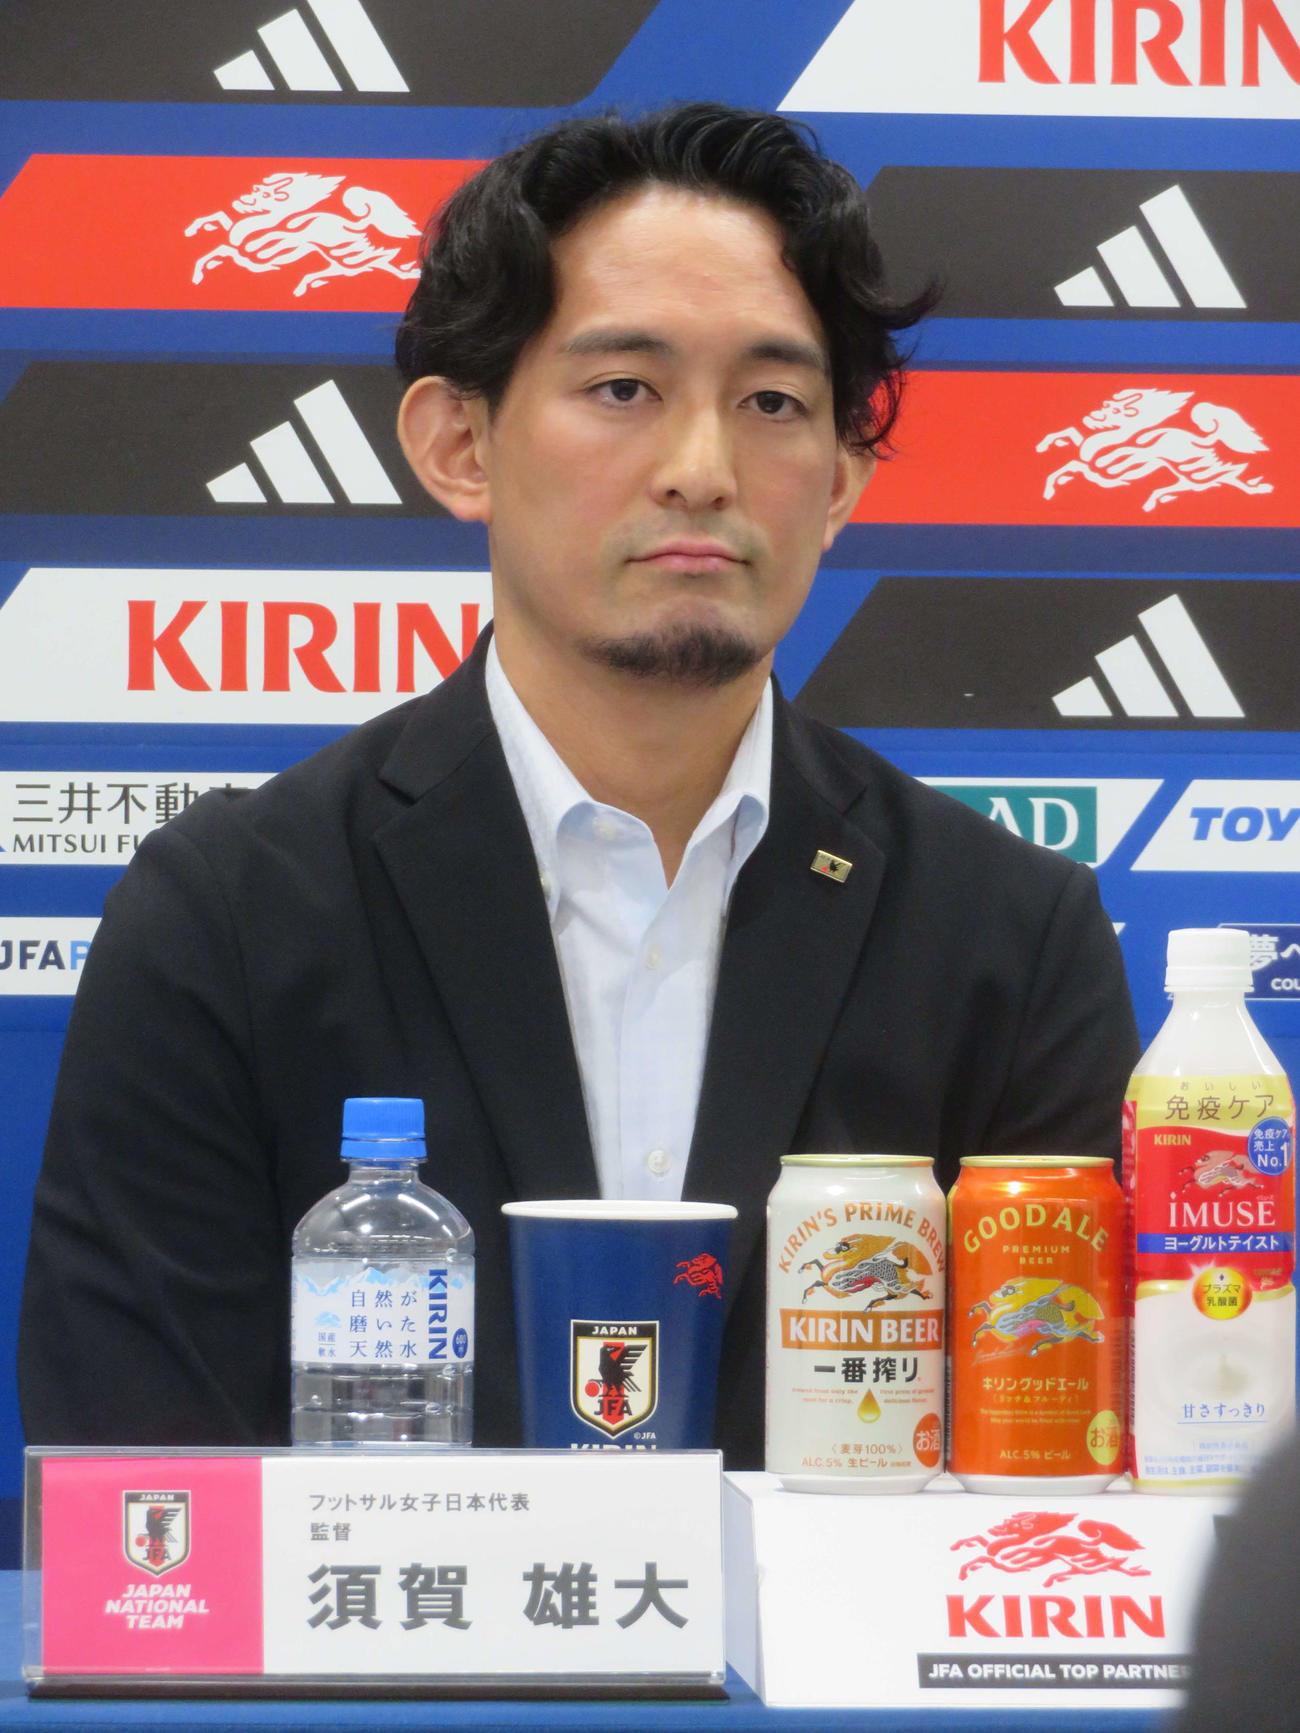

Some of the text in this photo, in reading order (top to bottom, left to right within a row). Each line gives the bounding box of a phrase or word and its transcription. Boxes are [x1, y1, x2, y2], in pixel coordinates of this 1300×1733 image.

[978, 0, 1300, 87] KIRIN
[127, 600, 481, 694] KIRIN
[13, 782, 249, 824] 三井不動
[13, 833, 106, 853] MITSUI
[1165, 1094, 1274, 1120] 免疫ケア
[1154, 1134, 1192, 1146] KIRIN
[1257, 1142, 1288, 1167] No.1
[1169, 1192, 1275, 1227] iMUSE
[778, 1207, 838, 1273] KIRIN'S
[844, 1202, 916, 1228] PRIME
[964, 1204, 1109, 1253] GOOD ALE
[1164, 1235, 1279, 1251] ヨーグルトテイスト
[351, 1289, 418, 1308] 自然が
[428, 1269, 448, 1359] KIRIN
[350, 1315, 417, 1333] 磨いた
[592, 1326, 637, 1335] JAPAN
[790, 1317, 938, 1343] KIRIN BEER
[350, 1340, 417, 1358] 天然水
[814, 1357, 919, 1383] 一番搾り
[594, 1400, 633, 1416] JFA
[1182, 1403, 1265, 1418] 甘さすっきり
[916, 1430, 941, 1451] お酒
[309, 1493, 530, 1512] フットサル女子日本代表
[310, 1522, 351, 1541] 監督
[143, 1549, 171, 1560] JFA
[122, 1584, 191, 1598] JAPAN
[307, 1562, 690, 1631] 須賀 雄大
[105, 1600, 209, 1613] NATIONAL
[126, 1615, 184, 1629] TEAM
[946, 1595, 1166, 1638] KIRIN
[928, 1663, 963, 1678] JFA
[967, 1663, 1055, 1679] OFFICIAL
[1060, 1664, 1099, 1679] TOP
